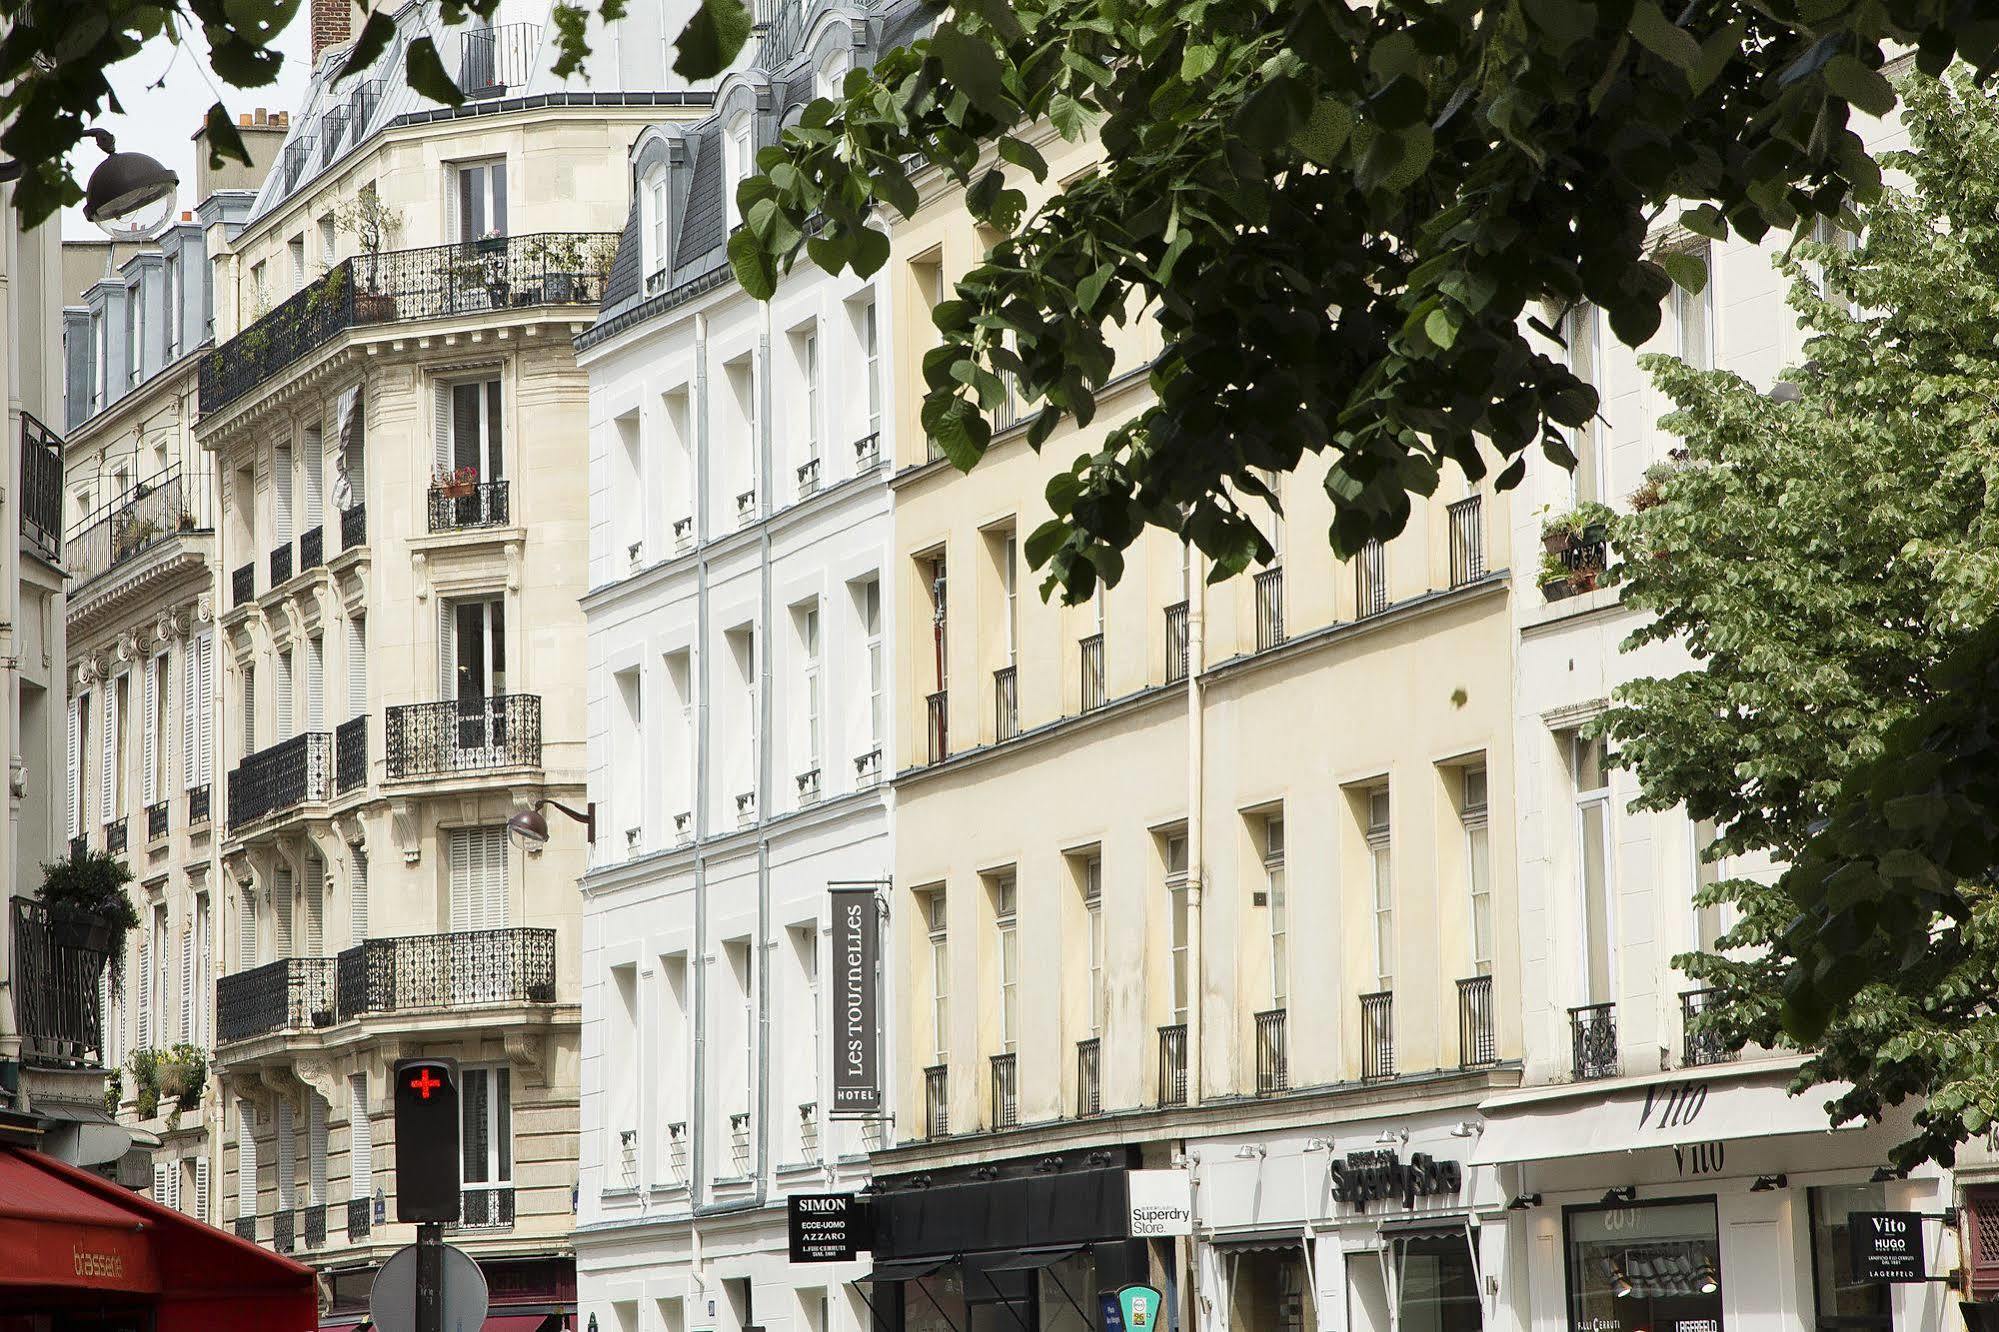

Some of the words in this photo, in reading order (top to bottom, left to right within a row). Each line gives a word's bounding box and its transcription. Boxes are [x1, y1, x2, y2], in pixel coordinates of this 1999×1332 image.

[838, 1091, 874, 1100] HOTEL
[1638, 1081, 1708, 1133] Vito
[799, 1199, 846, 1211] SIMON
[1133, 1208, 1190, 1223] Superdry
[802, 1221, 846, 1229] ECCE-UOMO
[1134, 1222, 1167, 1234] Store.
[1872, 1217, 1906, 1232] Vito
[803, 1233, 846, 1241] AZZARO
[1875, 1239, 1906, 1248] HUGO
